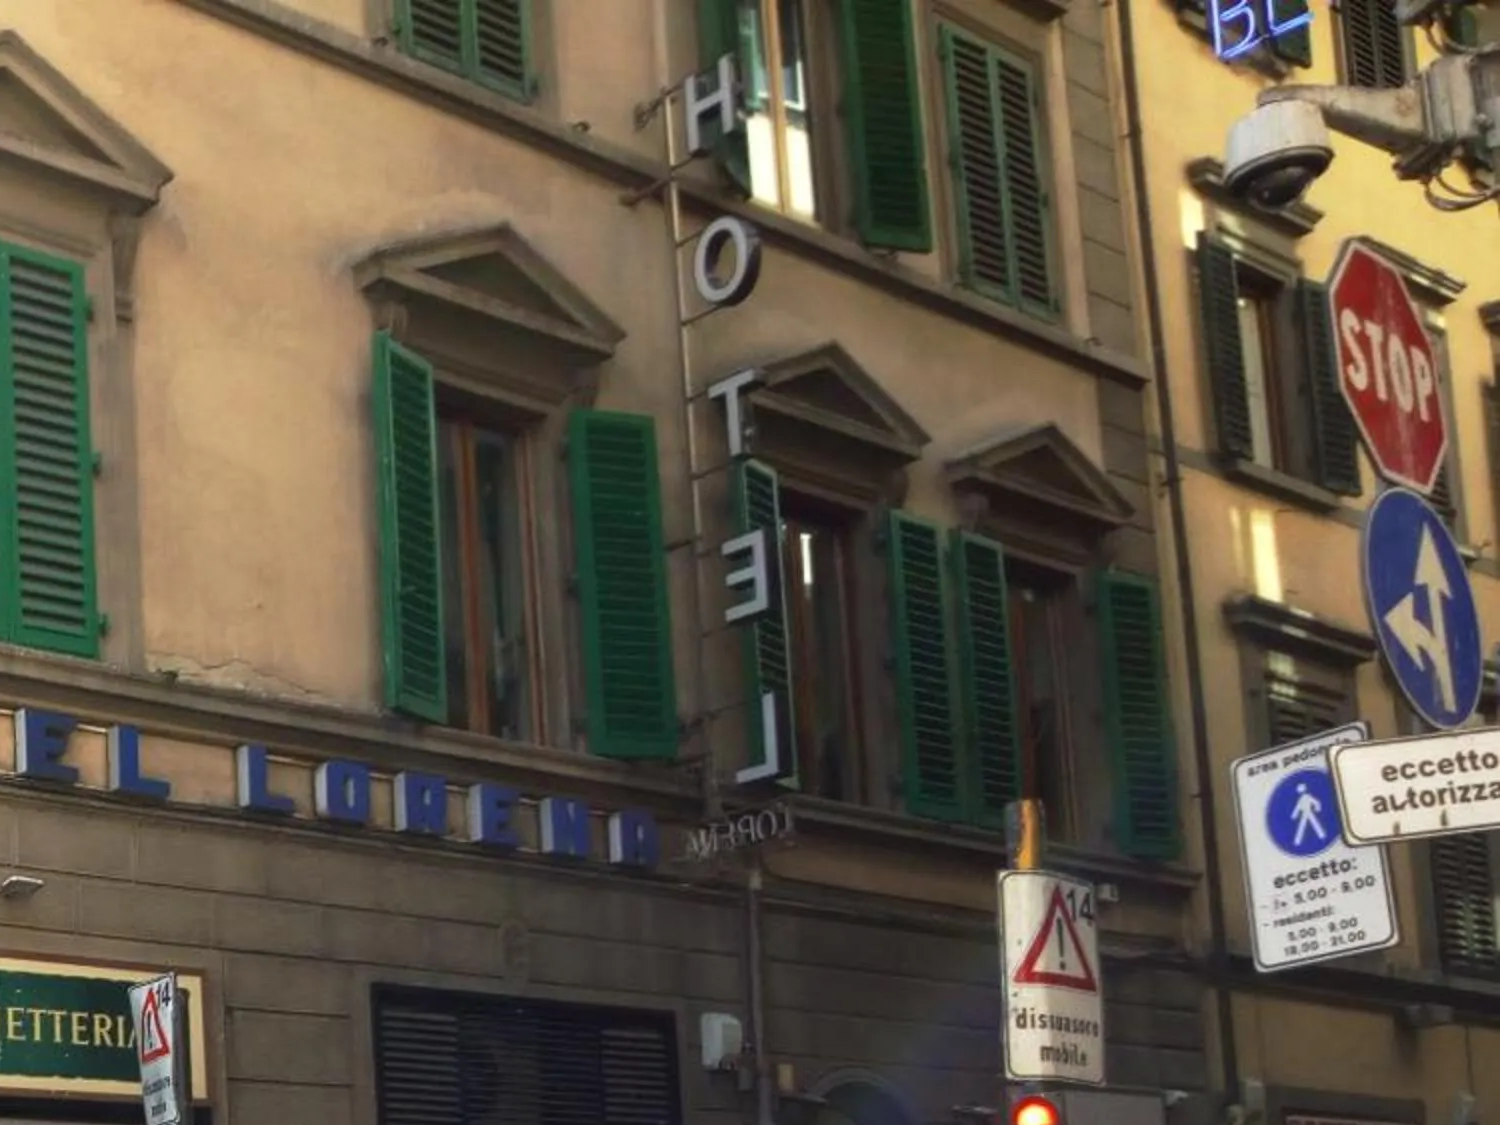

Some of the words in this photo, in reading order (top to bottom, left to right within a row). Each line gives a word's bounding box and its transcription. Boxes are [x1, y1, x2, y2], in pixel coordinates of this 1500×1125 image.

[1340, 307, 1432, 423] STOP
[1381, 749, 1499, 783] eccetto
[236, 743, 660, 868] LORENA
[1040, 1041, 1088, 1069] mobile
